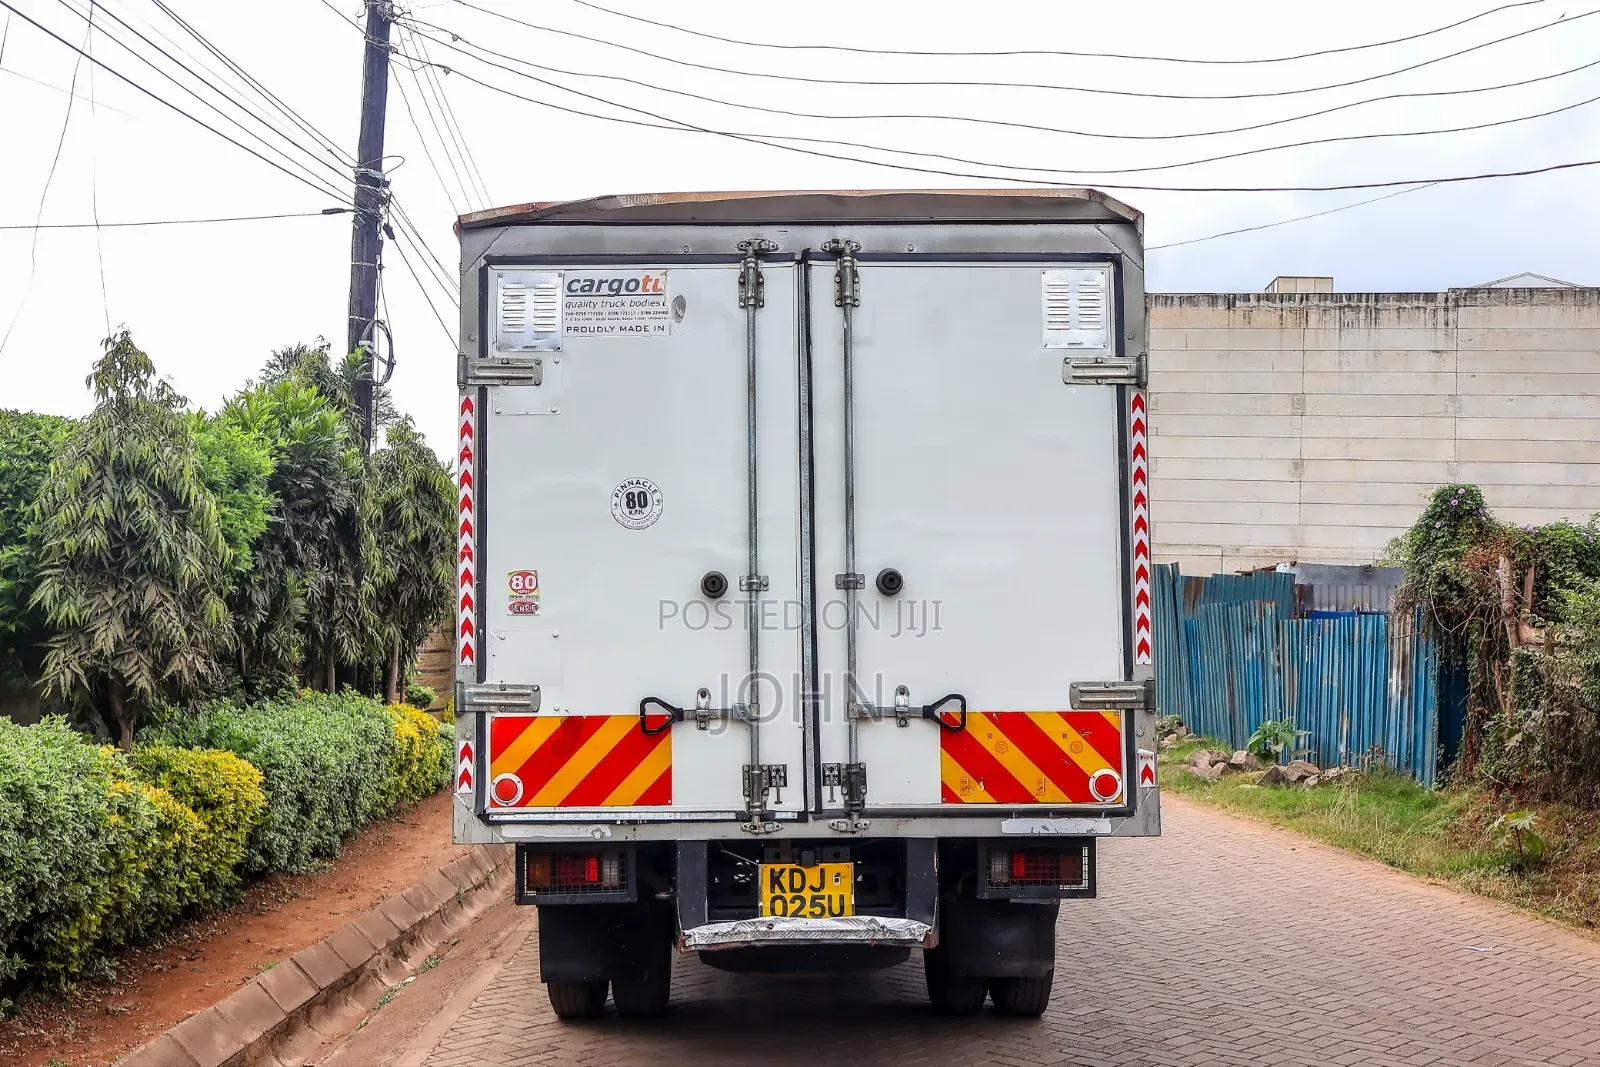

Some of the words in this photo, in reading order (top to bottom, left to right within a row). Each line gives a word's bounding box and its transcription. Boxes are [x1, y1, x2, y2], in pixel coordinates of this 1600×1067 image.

[565, 300, 598, 309] quality
[601, 300, 626, 308] truck
[630, 299, 660, 307] bodies
[614, 479, 658, 499] PINNACLE
[626, 491, 648, 509] 80
[511, 575, 537, 590] 80
[769, 867, 826, 894] KDJ
[769, 894, 845, 919] 025U
